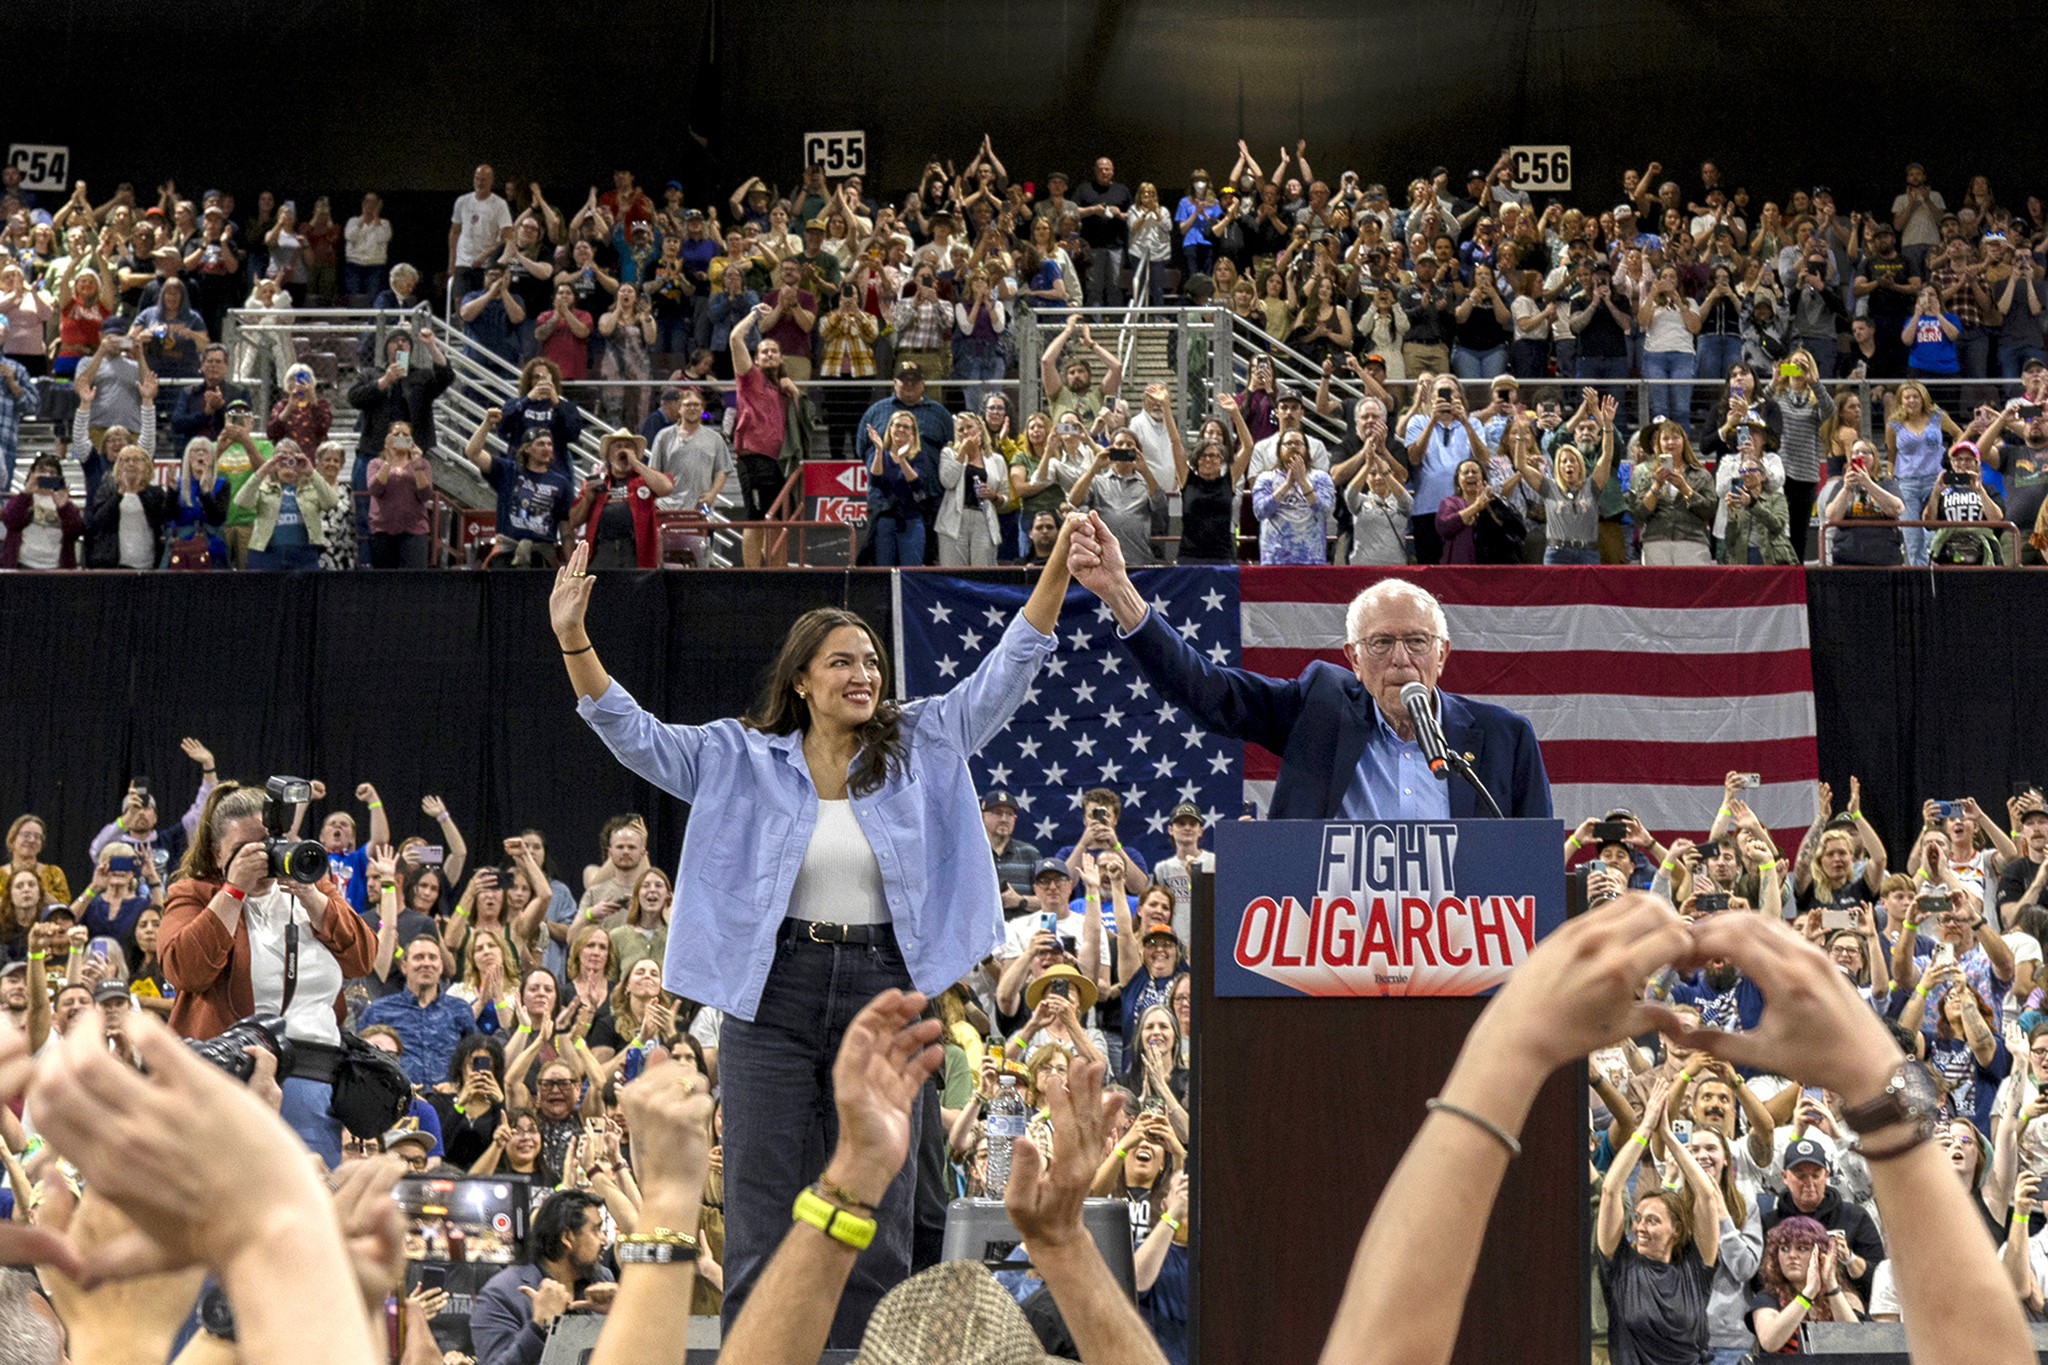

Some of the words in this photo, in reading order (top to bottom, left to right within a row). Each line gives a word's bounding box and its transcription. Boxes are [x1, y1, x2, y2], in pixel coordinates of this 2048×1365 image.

[807, 137, 863, 169] C55
[1512, 151, 1569, 184] C56
[1318, 824, 1458, 892] FIGHT
[1234, 896, 1536, 968] OLIGARCHY
[287, 952, 295, 979] Canon
[1375, 973, 1408, 984] Bernie
